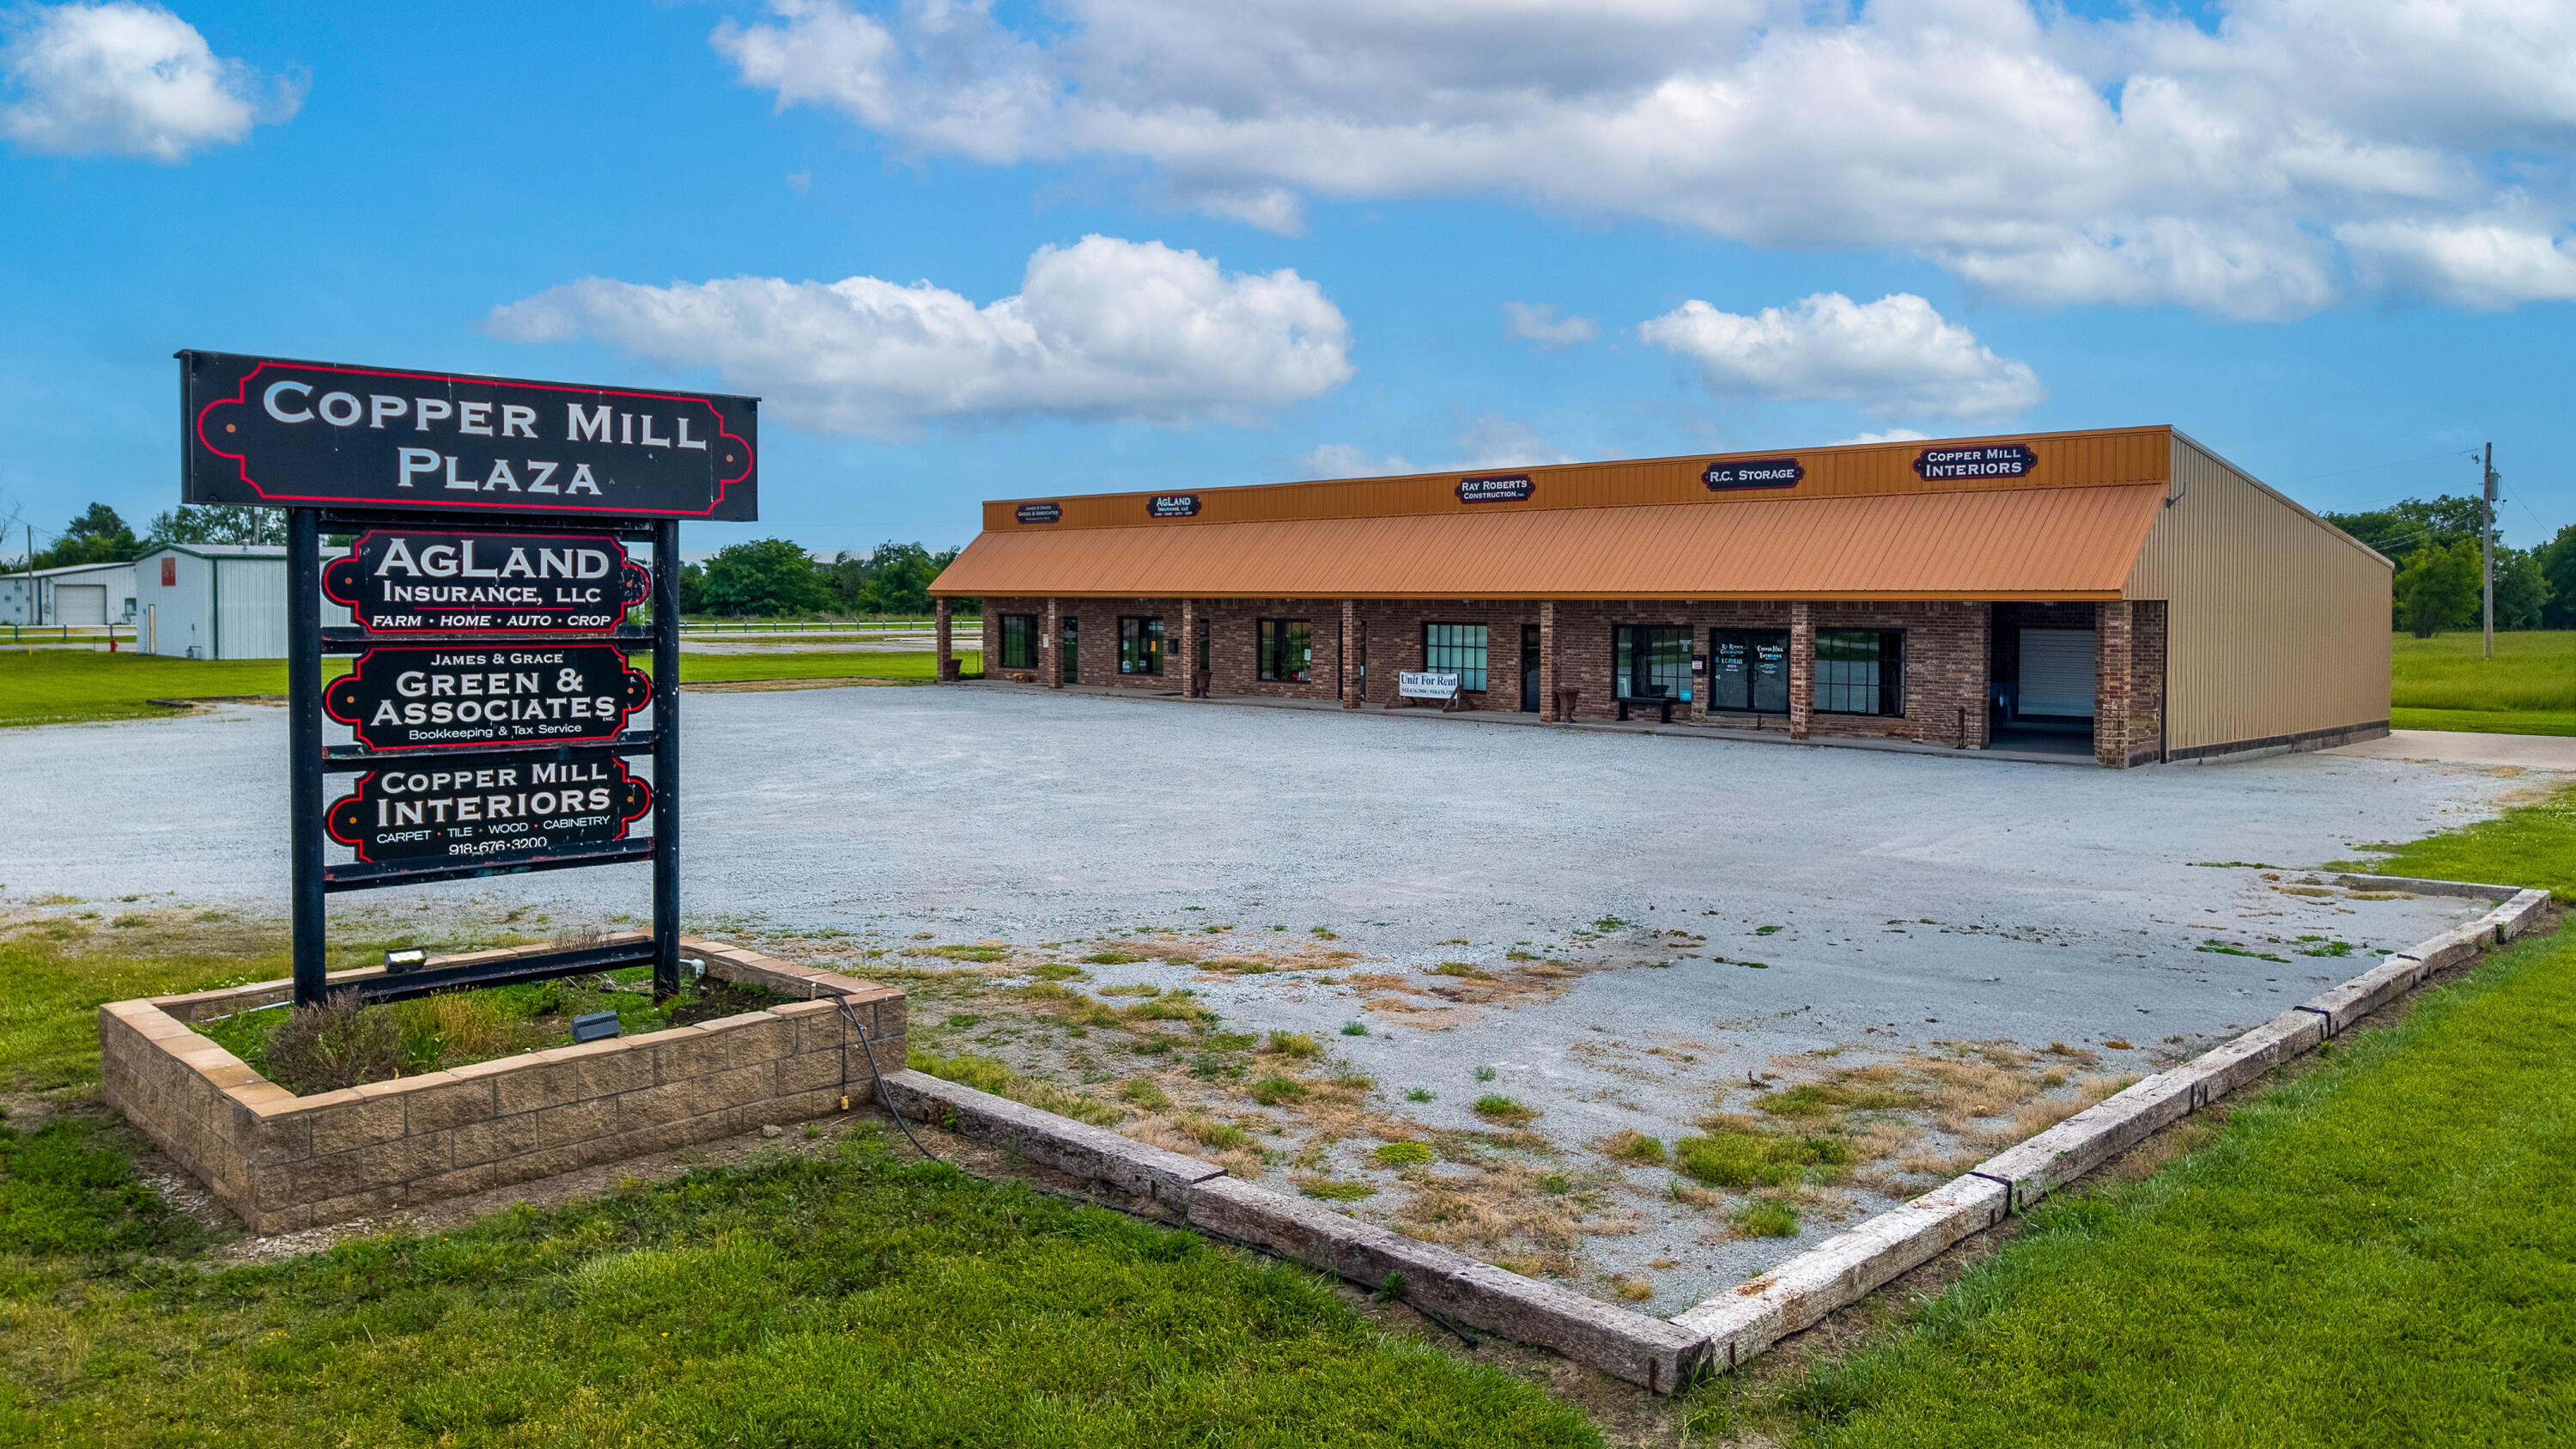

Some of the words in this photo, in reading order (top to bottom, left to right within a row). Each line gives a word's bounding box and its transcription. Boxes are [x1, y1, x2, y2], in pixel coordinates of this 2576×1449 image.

[264, 381, 538, 438] COPPER
[567, 403, 707, 450] MILL
[1928, 452, 1981, 462] COPPER
[1986, 449, 2020, 459] MILL
[398, 447, 603, 496] PLAZA
[1710, 471, 1733, 482] R.C.
[1739, 469, 1795, 480] STORAGE
[1926, 462, 2022, 477] INTERIORS
[1461, 482, 1479, 491] RAY
[1483, 480, 1528, 490] ROBERTS
[1157, 496, 1191, 507] AGLAND
[374, 538, 610, 579] AGLAND
[383, 580, 543, 605] INSURANCE,
[556, 587, 601, 603] LLC
[372, 615, 422, 627] FARM
[440, 615, 490, 626] HOME
[507, 615, 551, 626] AUTO
[568, 615, 611, 626] CROP
[431, 654, 486, 666] JAMES
[493, 654, 505, 665] &
[510, 653, 563, 665] GRACE
[396, 671, 538, 697] GREEN
[557, 667, 583, 692] &
[1401, 674, 1419, 685] Unit
[1421, 675, 1436, 685] For
[1437, 675, 1456, 686] Rent
[370, 697, 615, 726] ASSOCIATES
[410, 727, 493, 740] Bookkeeping
[498, 726, 507, 736] &
[513, 725, 533, 735] Tax
[538, 723, 582, 734] Service
[381, 769, 517, 794] COPPER
[532, 763, 608, 783] MILL
[377, 788, 611, 827] INTERIORS
[377, 830, 431, 843] CARPET
[447, 826, 472, 838] TILE
[488, 822, 529, 834] WOOD
[544, 815, 611, 830] CABINETRY
